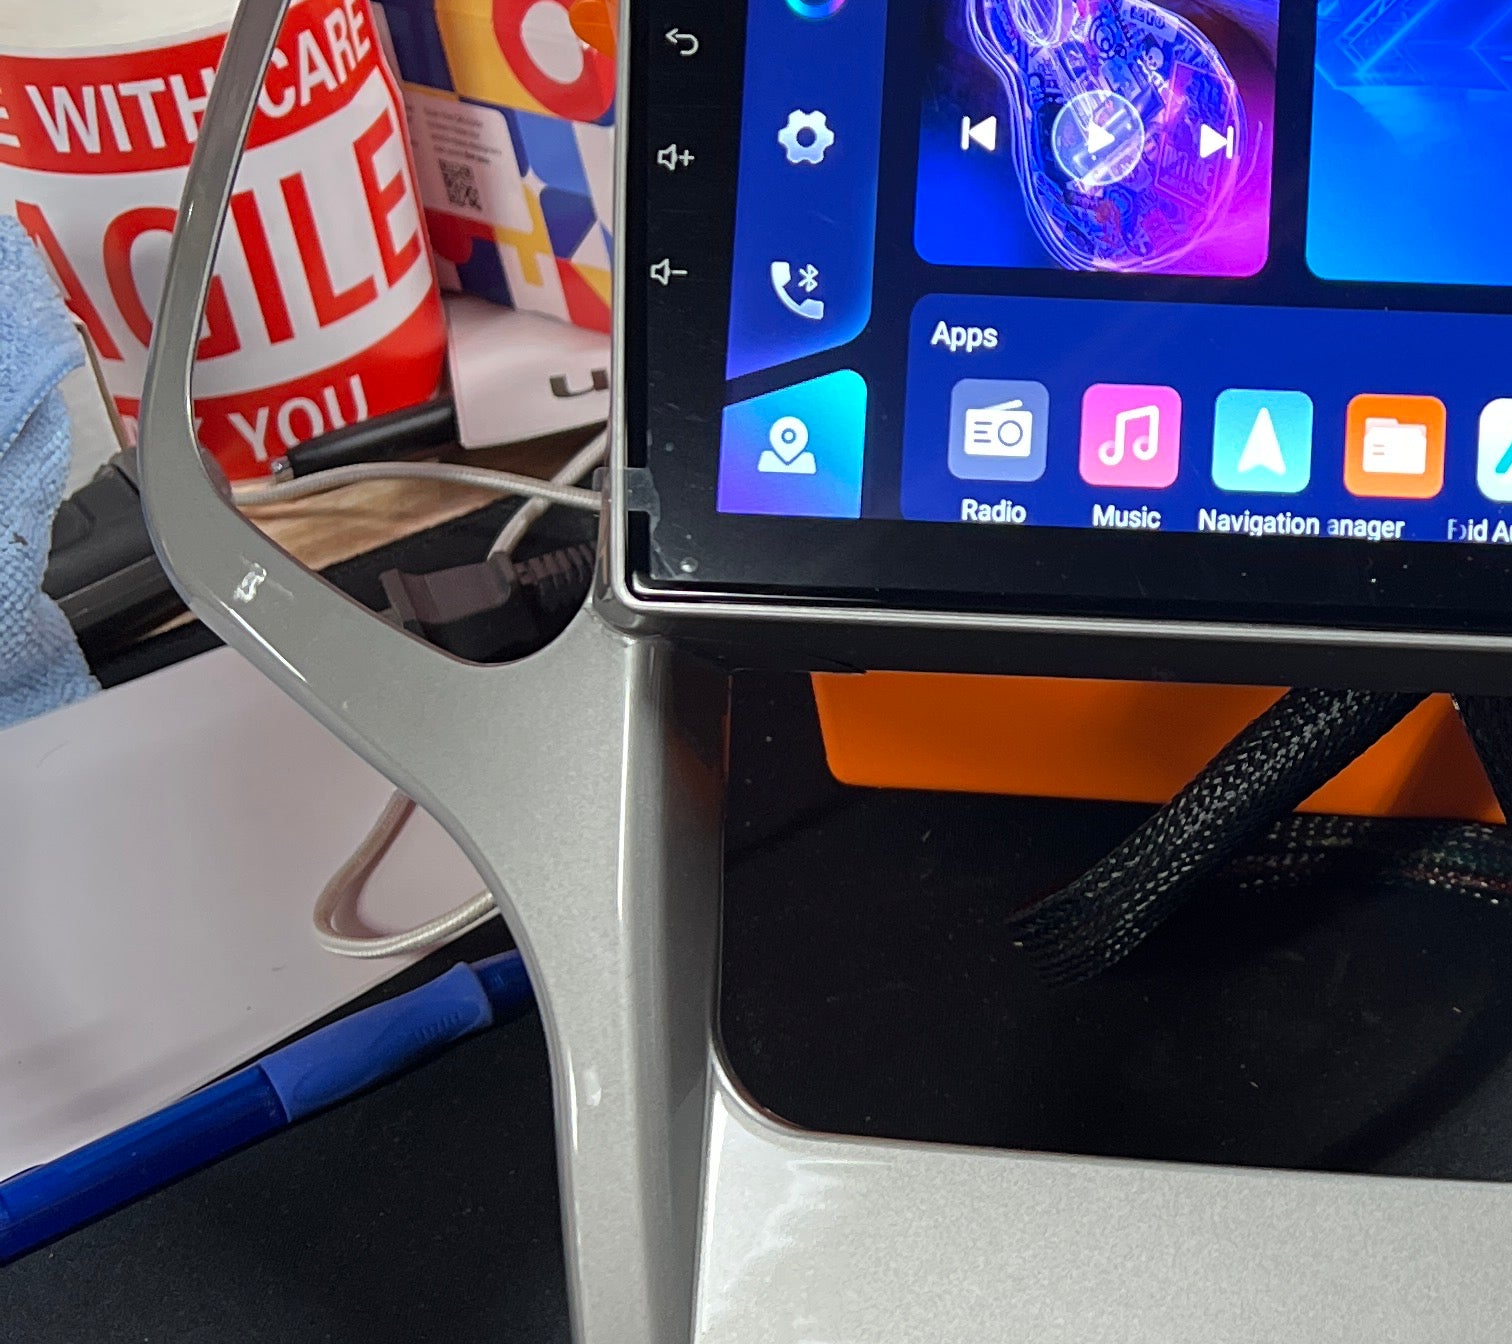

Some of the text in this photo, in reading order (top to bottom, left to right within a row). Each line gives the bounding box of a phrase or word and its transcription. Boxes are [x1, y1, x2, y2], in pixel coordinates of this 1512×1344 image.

[25, 65, 218, 154] WITH
[931, 321, 998, 354] Apps
[228, 374, 369, 462] YOU
[961, 499, 1027, 525] Radio
[1092, 504, 1162, 530] Music
[1198, 508, 1320, 537] Navigation
[1327, 518, 1405, 542] anager
